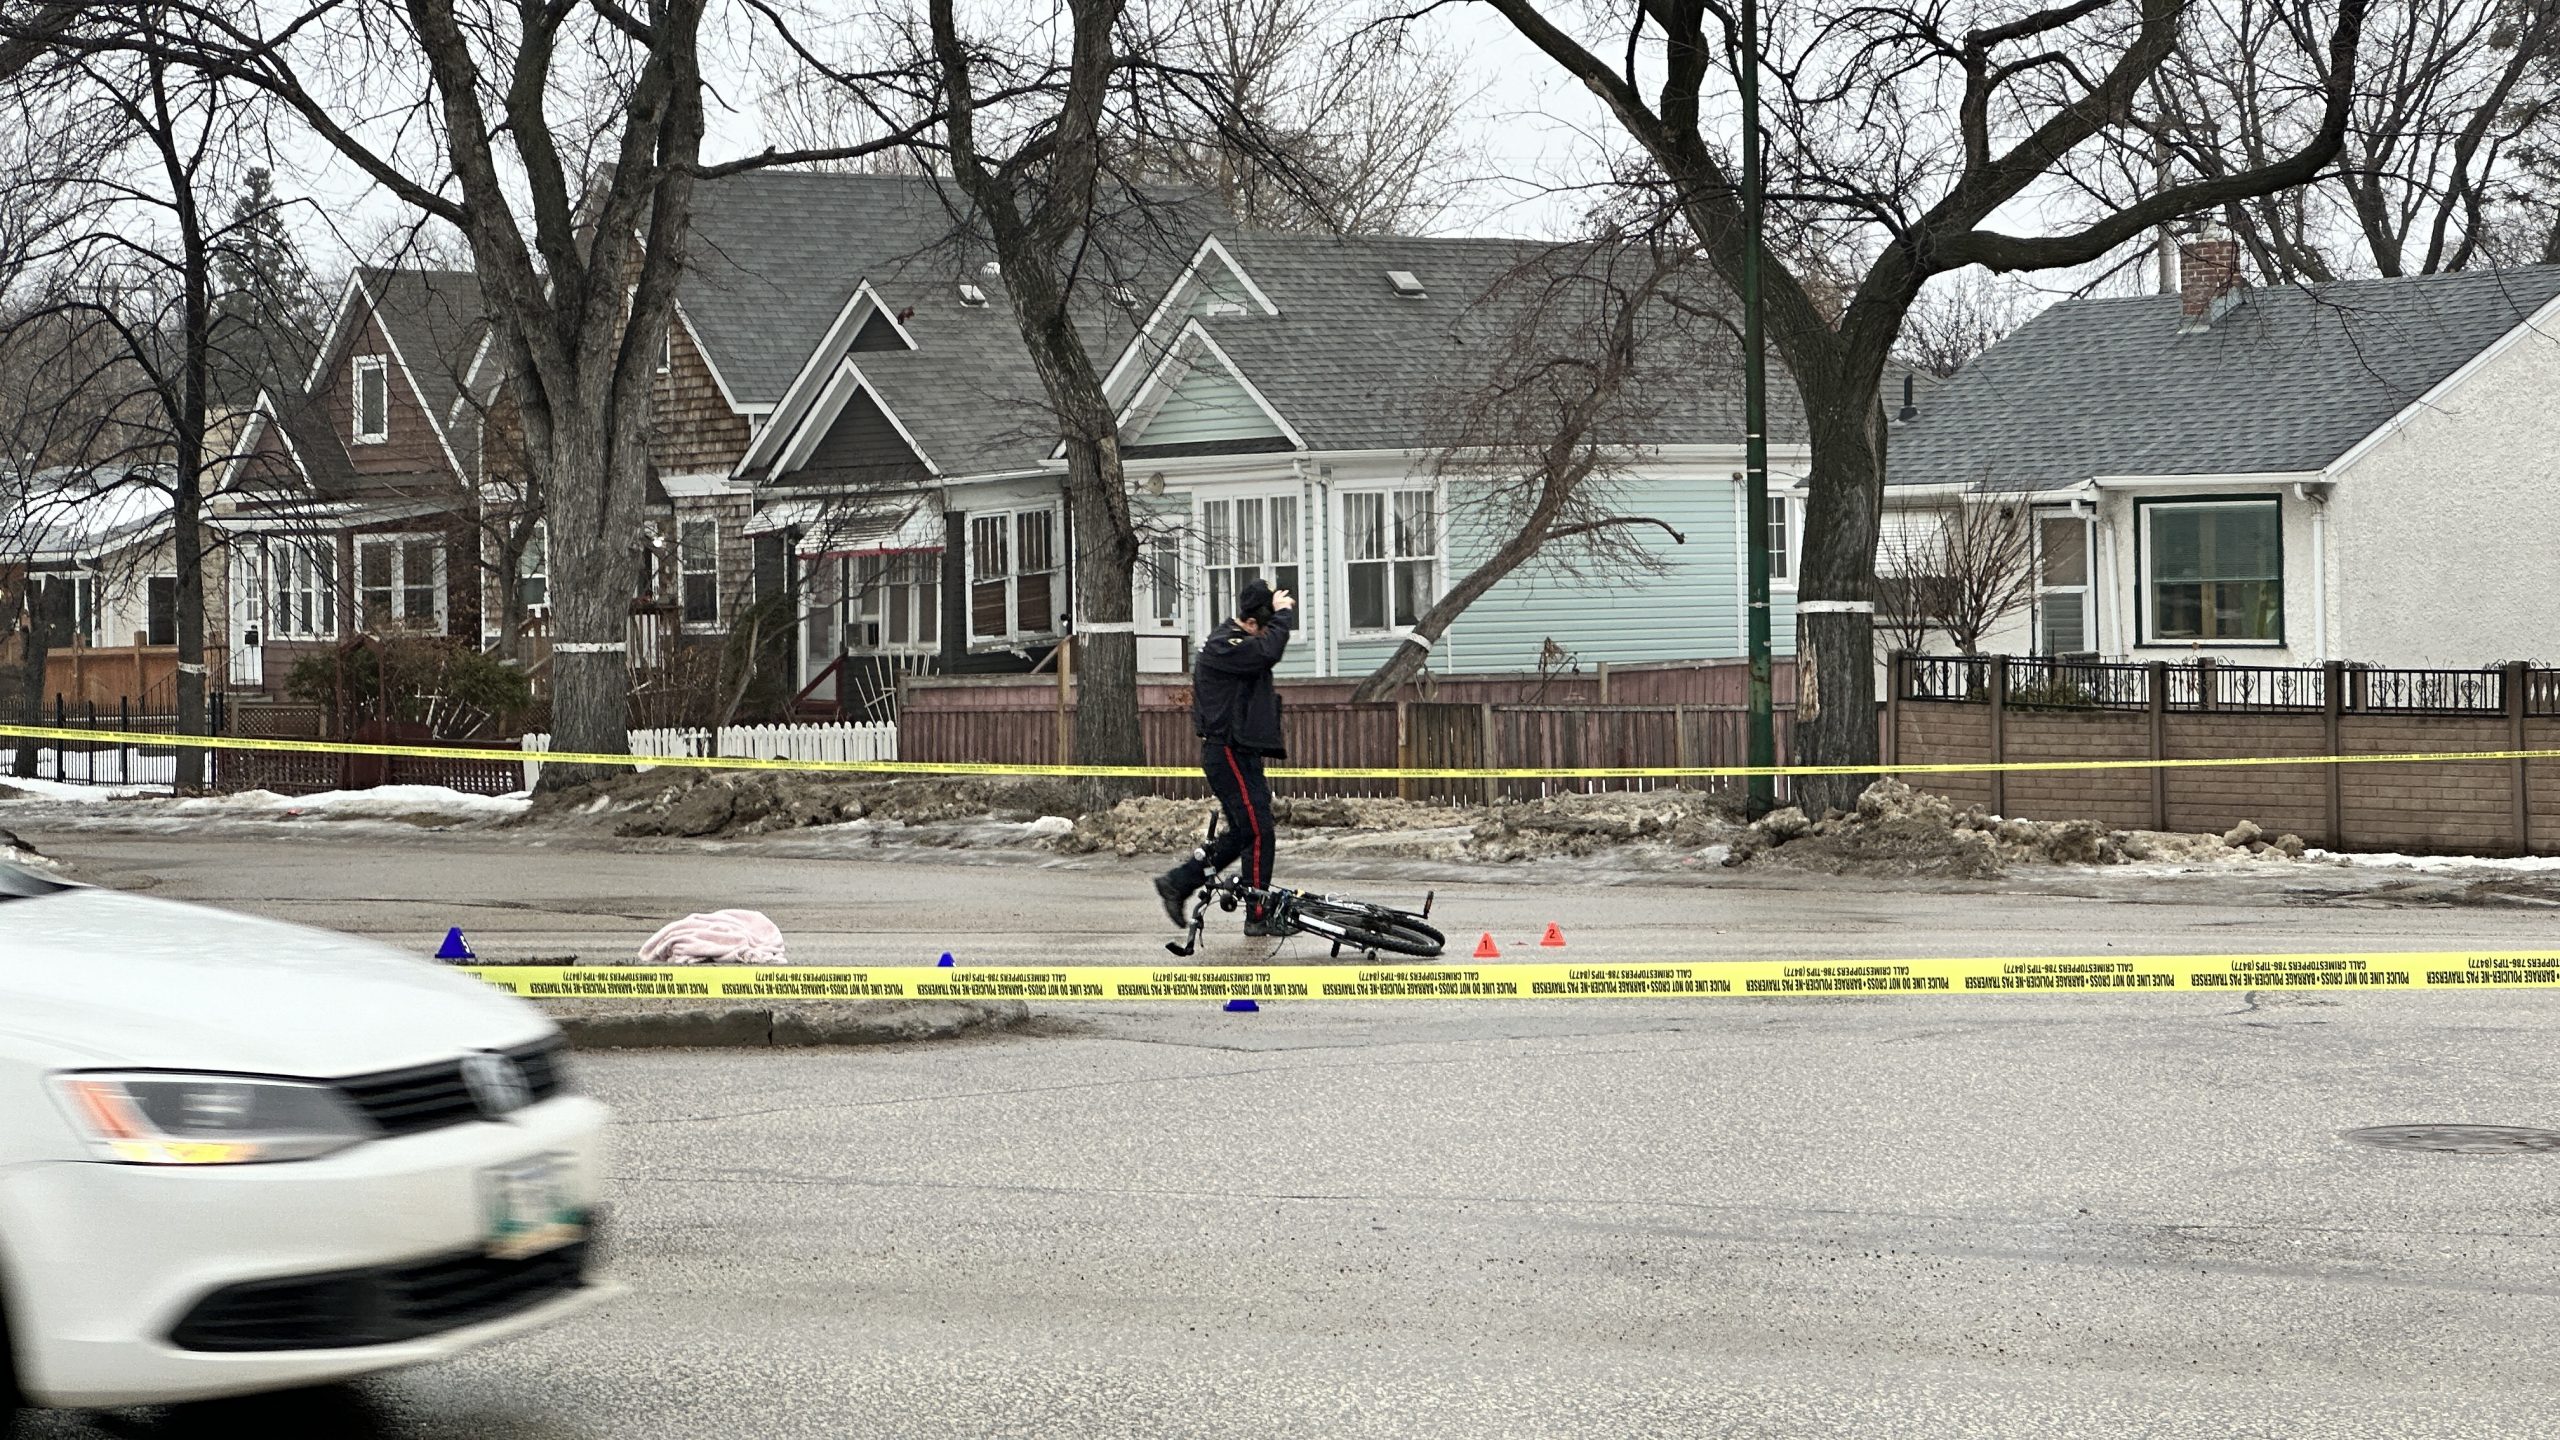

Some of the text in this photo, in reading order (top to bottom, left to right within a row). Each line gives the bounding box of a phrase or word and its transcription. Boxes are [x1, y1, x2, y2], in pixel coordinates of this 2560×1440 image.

[1549, 929, 1556, 939] 2
[1483, 940, 1488, 950] 1
[2231, 961, 2366, 971] CALL CRIMESTOPPERS 786-TIPS (8477)
[2468, 958, 2560, 968] TOPPERS 786-TIPS (8477)
[1783, 967, 1909, 977] CALL CRIMESTOPPERS 786-TIPS (8477)
[2003, 963, 2133, 974] CALL CRIMESTOPPERS 786-TIPS (8477)
[562, 972, 673, 981] CALL CRIMESTOPPERS 786-TIPS (8477)
[755, 973, 867, 982] CALL CRIMESTOPPERS 786-TIPS (8477)
[951, 973, 1066, 982] CALL CRIMESTOPPERS 786-TIPS (8477)
[1152, 973, 1270, 982] CALL CRIMESTOPPERS 786-TIPS (8477)
[1358, 972, 1479, 981] CALL CRIMESTOPPERS 786-TIPS (8477)
[1569, 970, 1692, 979] CALL CRIMESTOPPERS 786-TIPS (8477)
[2190, 972, 2409, 986] POLICE LINE DO NOT CROSS BARRAGE POLICIER-NE PAS TRAVERSER
[2426, 970, 2555, 984] BARRAGE POLICIER-NE PAS TRAVERSER
[1745, 977, 1949, 991] POLICE LINE DO NOT CROSS BARRAGE POLICIER-NE PAS TRAVERSER
[1964, 974, 2174, 988] POLICE LINE DO NOT CROSS BARRAGE POLICIER-NE PAS TRAVERSER
[529, 983, 708, 994] POLICE LINE DO NOT CROSS BARRAGE POLICIER-NE PAS TRAVERSER
[721, 984, 903, 995] POLICE LINE DO NOT CROSS BARRAGE POLICIER-NE PAS TRAVERSER
[916, 984, 1103, 995] POLICE LINE DO NOT CROSS BARRAGE POLICIER-NE PAS TRAVERSER
[1116, 984, 1308, 995] POLICE LINE DO NOT CROSS BARRAGE POLICIER-NE PAS TRAVERSER
[1322, 982, 1517, 995] POLICE LINE DO NOT CROSS BARRAGE POLICIER-NE PAS TRAVERSER
[1532, 980, 1731, 994] POLICE LINE DO NOT CROSS BARRAGE POLICIER-NE PAS TRAVERSER
